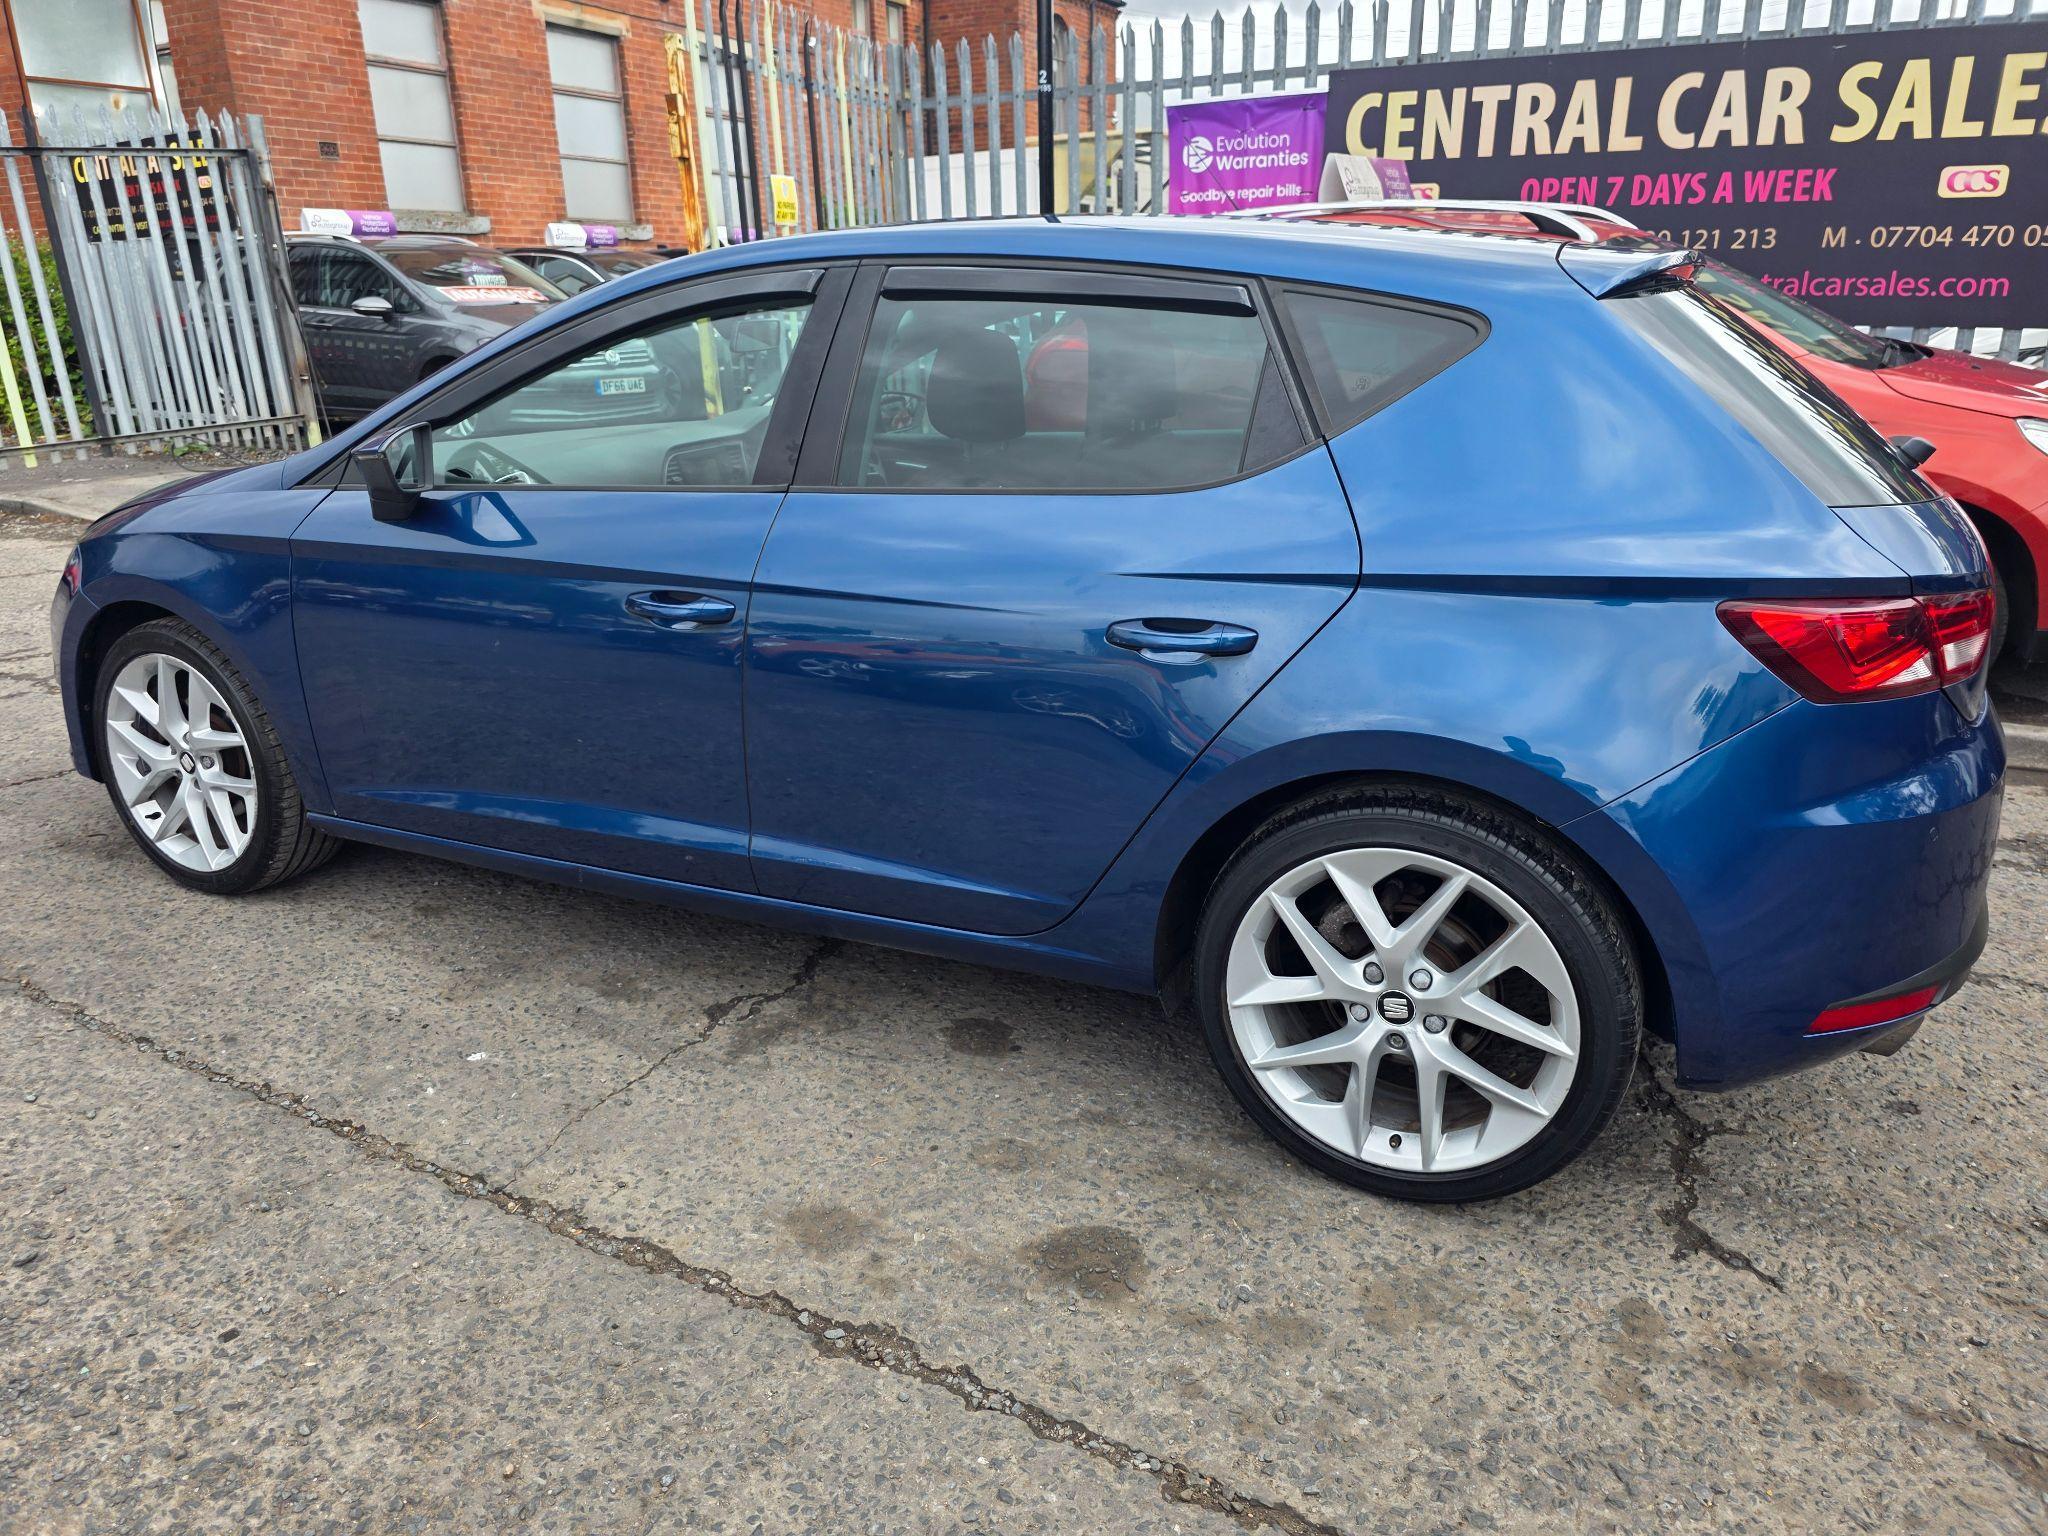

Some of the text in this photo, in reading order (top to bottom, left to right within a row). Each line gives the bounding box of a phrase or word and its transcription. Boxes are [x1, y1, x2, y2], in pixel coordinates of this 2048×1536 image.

[1039, 70, 1047, 83] 2
[1345, 52, 2048, 161] CENTRAL CAR SALE
[1216, 132, 1291, 152] Evolution
[1216, 150, 1309, 171] Warranties
[1520, 168, 1838, 206] OPEN 7 DAYS A WEEK
[1946, 169, 2002, 193] CCS
[1180, 188, 1235, 204] Goodbye
[1237, 185, 1275, 203] repair
[1682, 229, 1720, 249] 121
[1730, 227, 1777, 249] 213
[1821, 226, 1847, 248] M
[1870, 225, 1954, 248] 07704
[1961, 225, 2015, 247] 470
